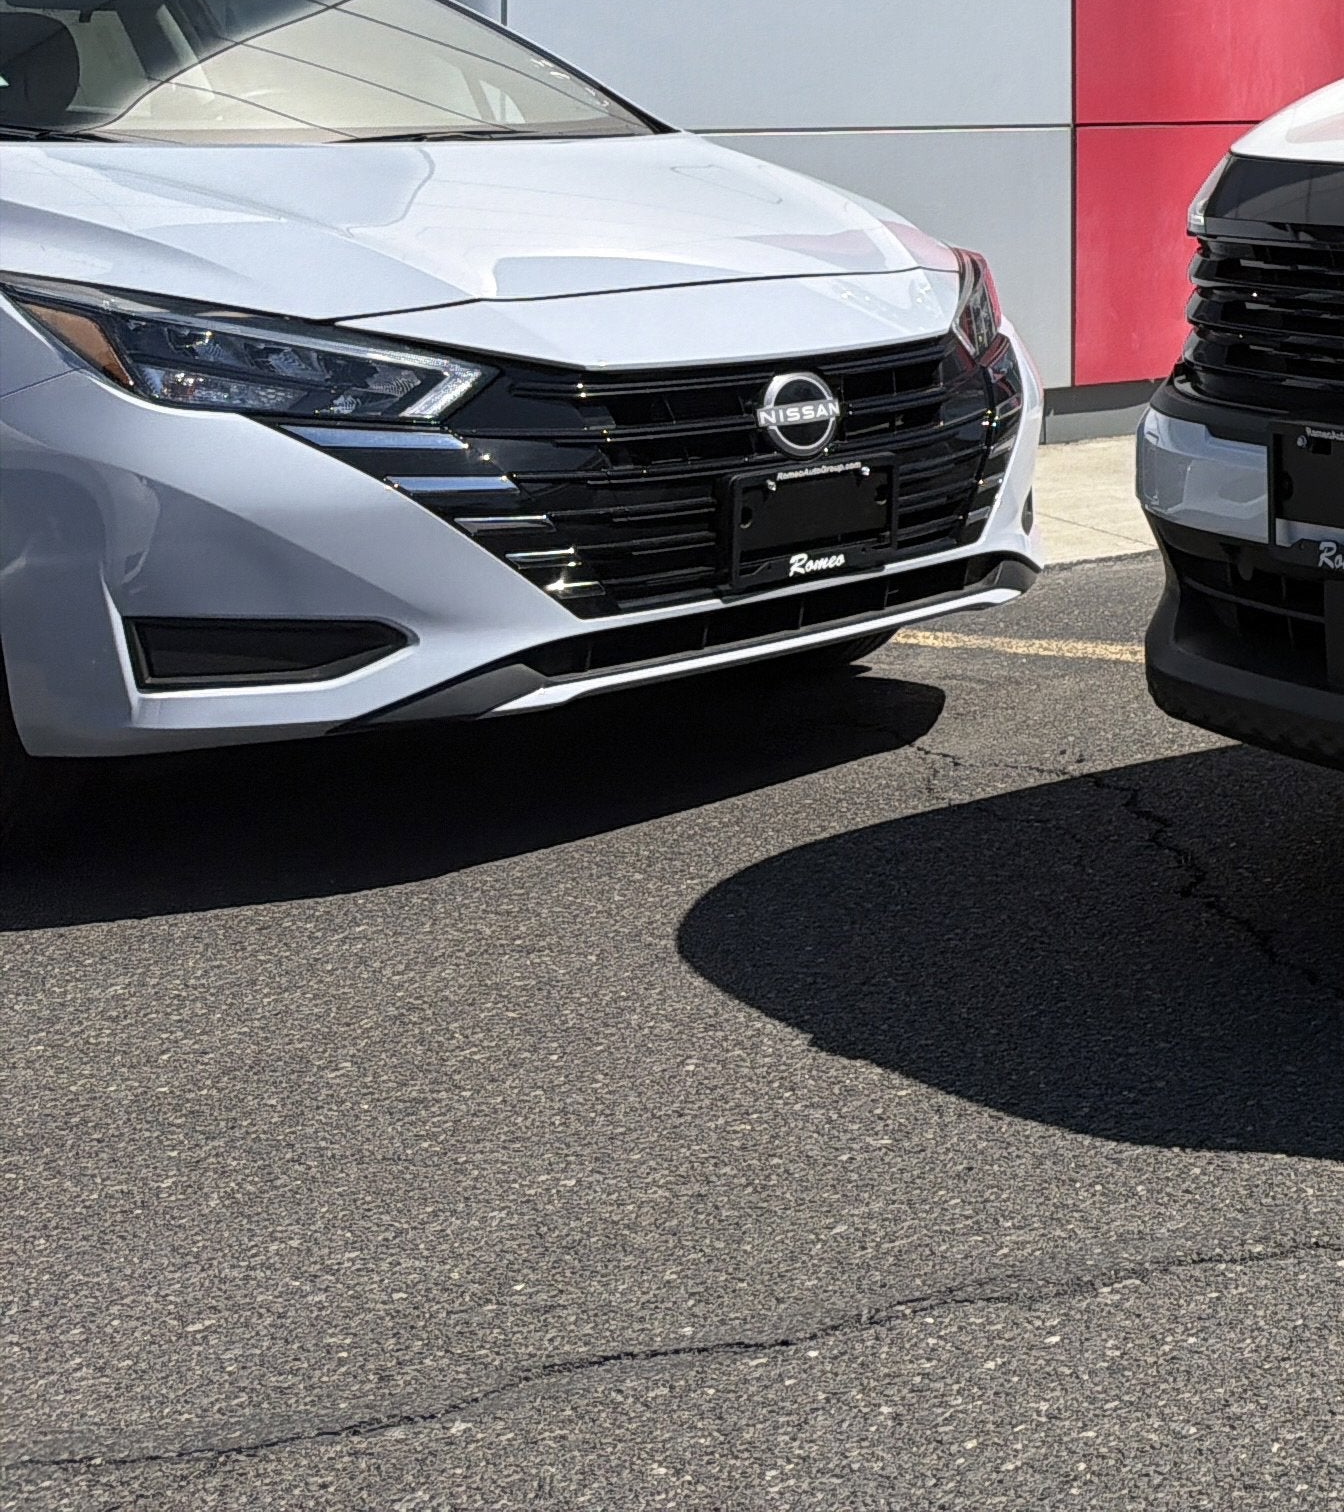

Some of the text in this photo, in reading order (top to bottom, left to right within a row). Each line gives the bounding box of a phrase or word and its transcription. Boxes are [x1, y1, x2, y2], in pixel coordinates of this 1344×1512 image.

[759, 402, 840, 426] NISSAN
[776, 461, 862, 481] RomeoAutoGroup.com
[788, 552, 846, 578] Romeo
